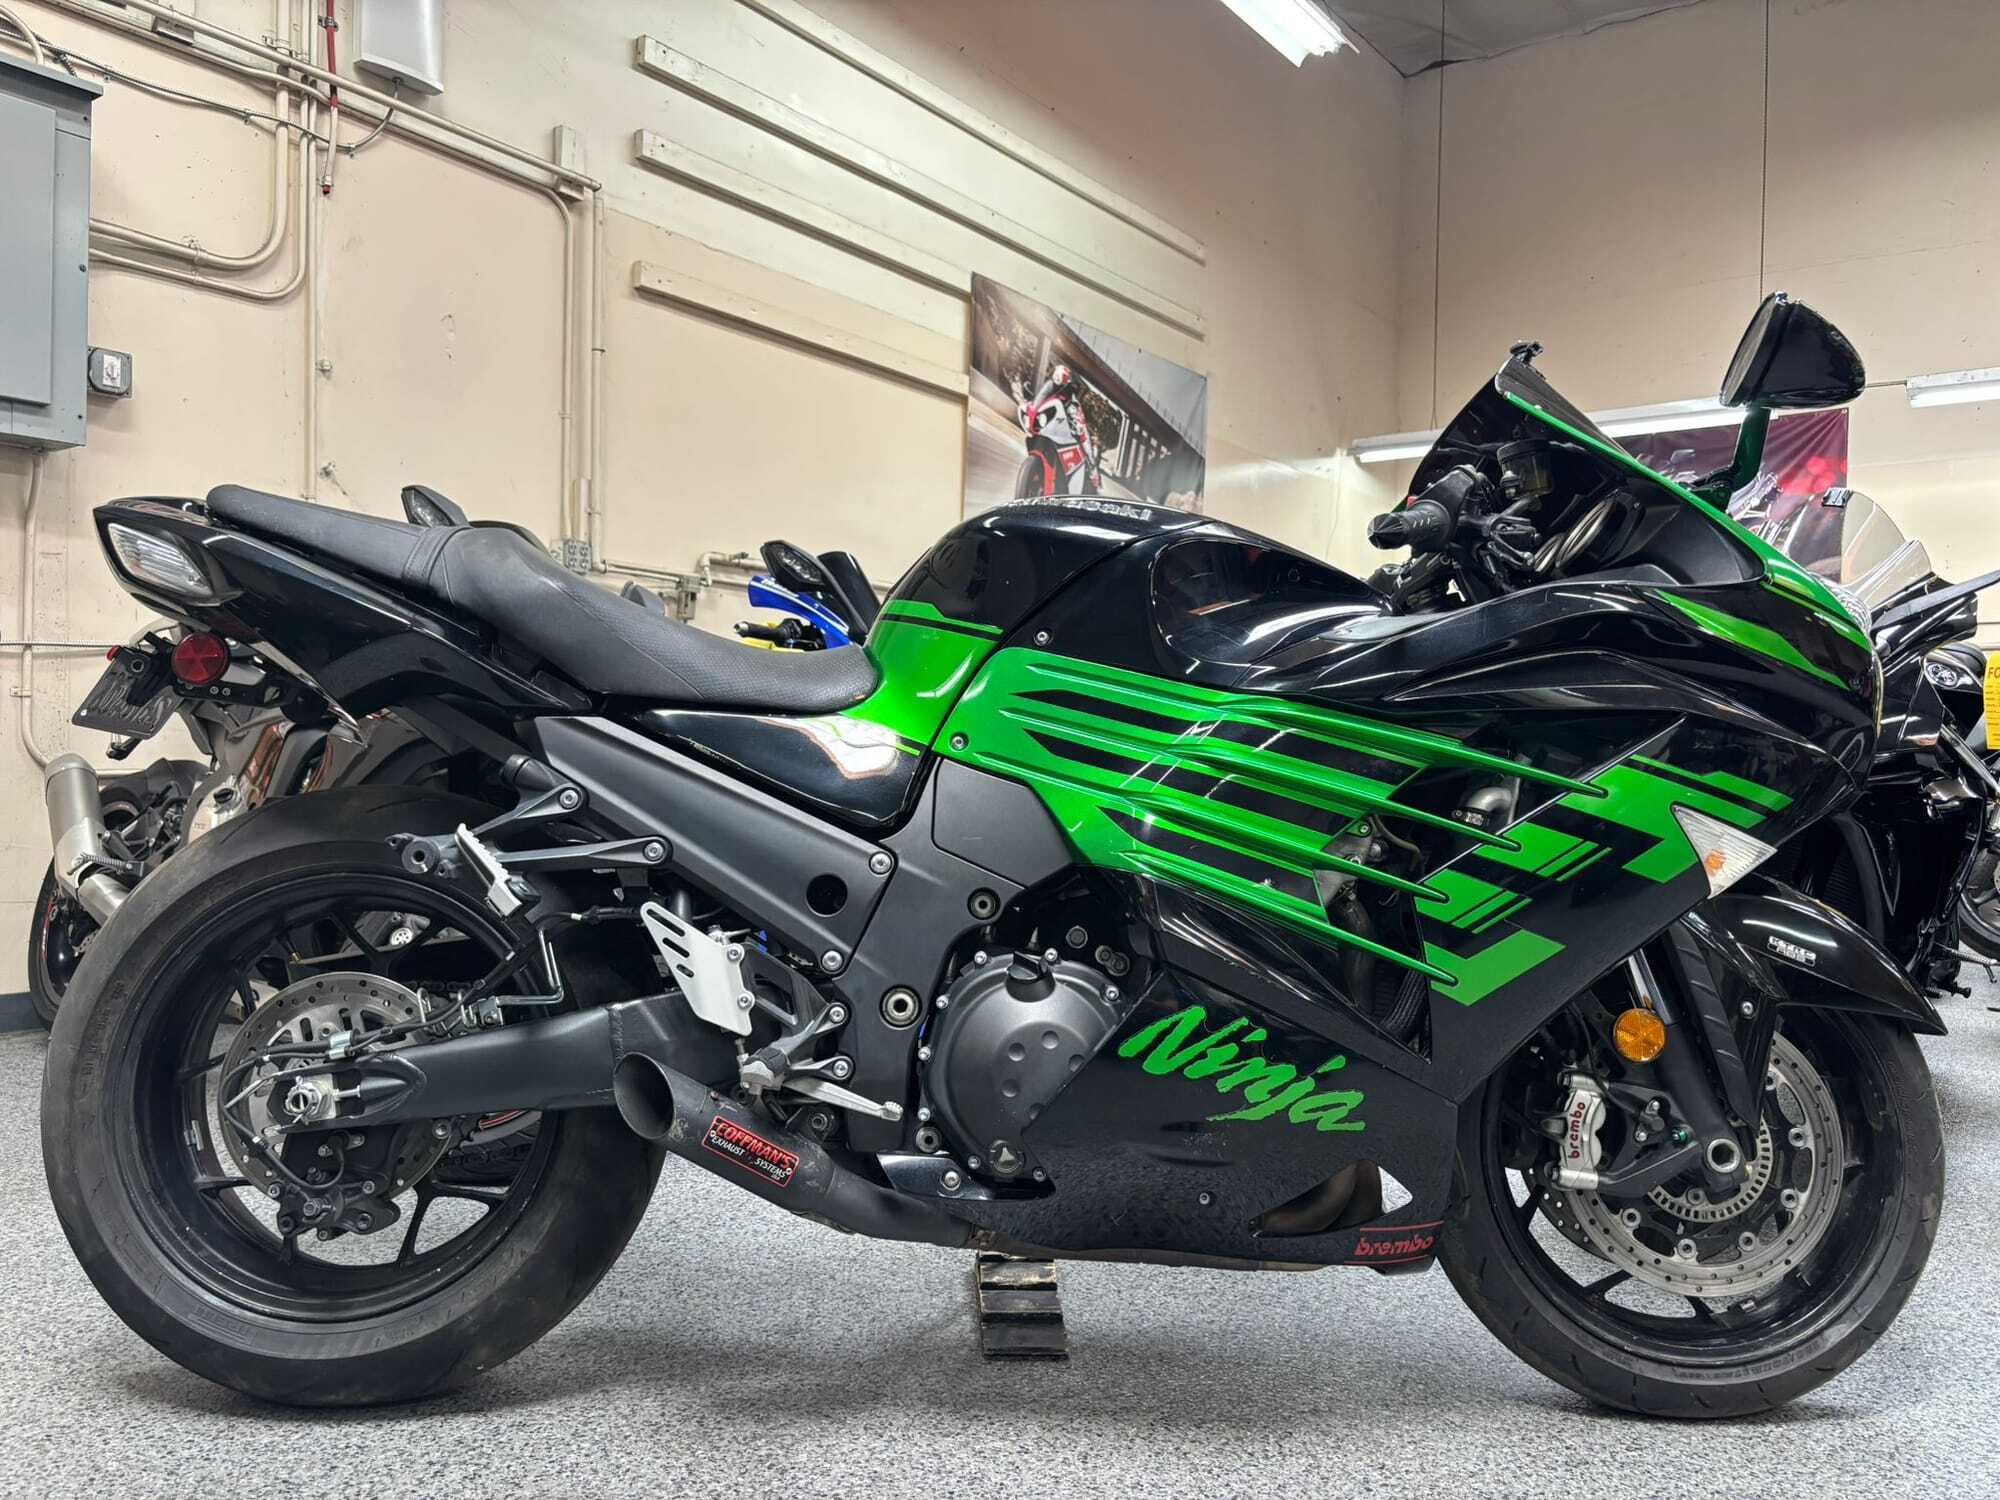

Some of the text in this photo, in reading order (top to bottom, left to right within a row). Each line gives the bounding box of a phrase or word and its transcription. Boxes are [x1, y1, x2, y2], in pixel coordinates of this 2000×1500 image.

[1117, 1005, 1366, 1131] Ninja
[716, 1122, 794, 1169] COFFMAN'S
[1568, 1102, 1586, 1159] brembo
[711, 1136, 787, 1178] EXHAUST SYSTEMS
[1354, 1234, 1436, 1256] brembo
